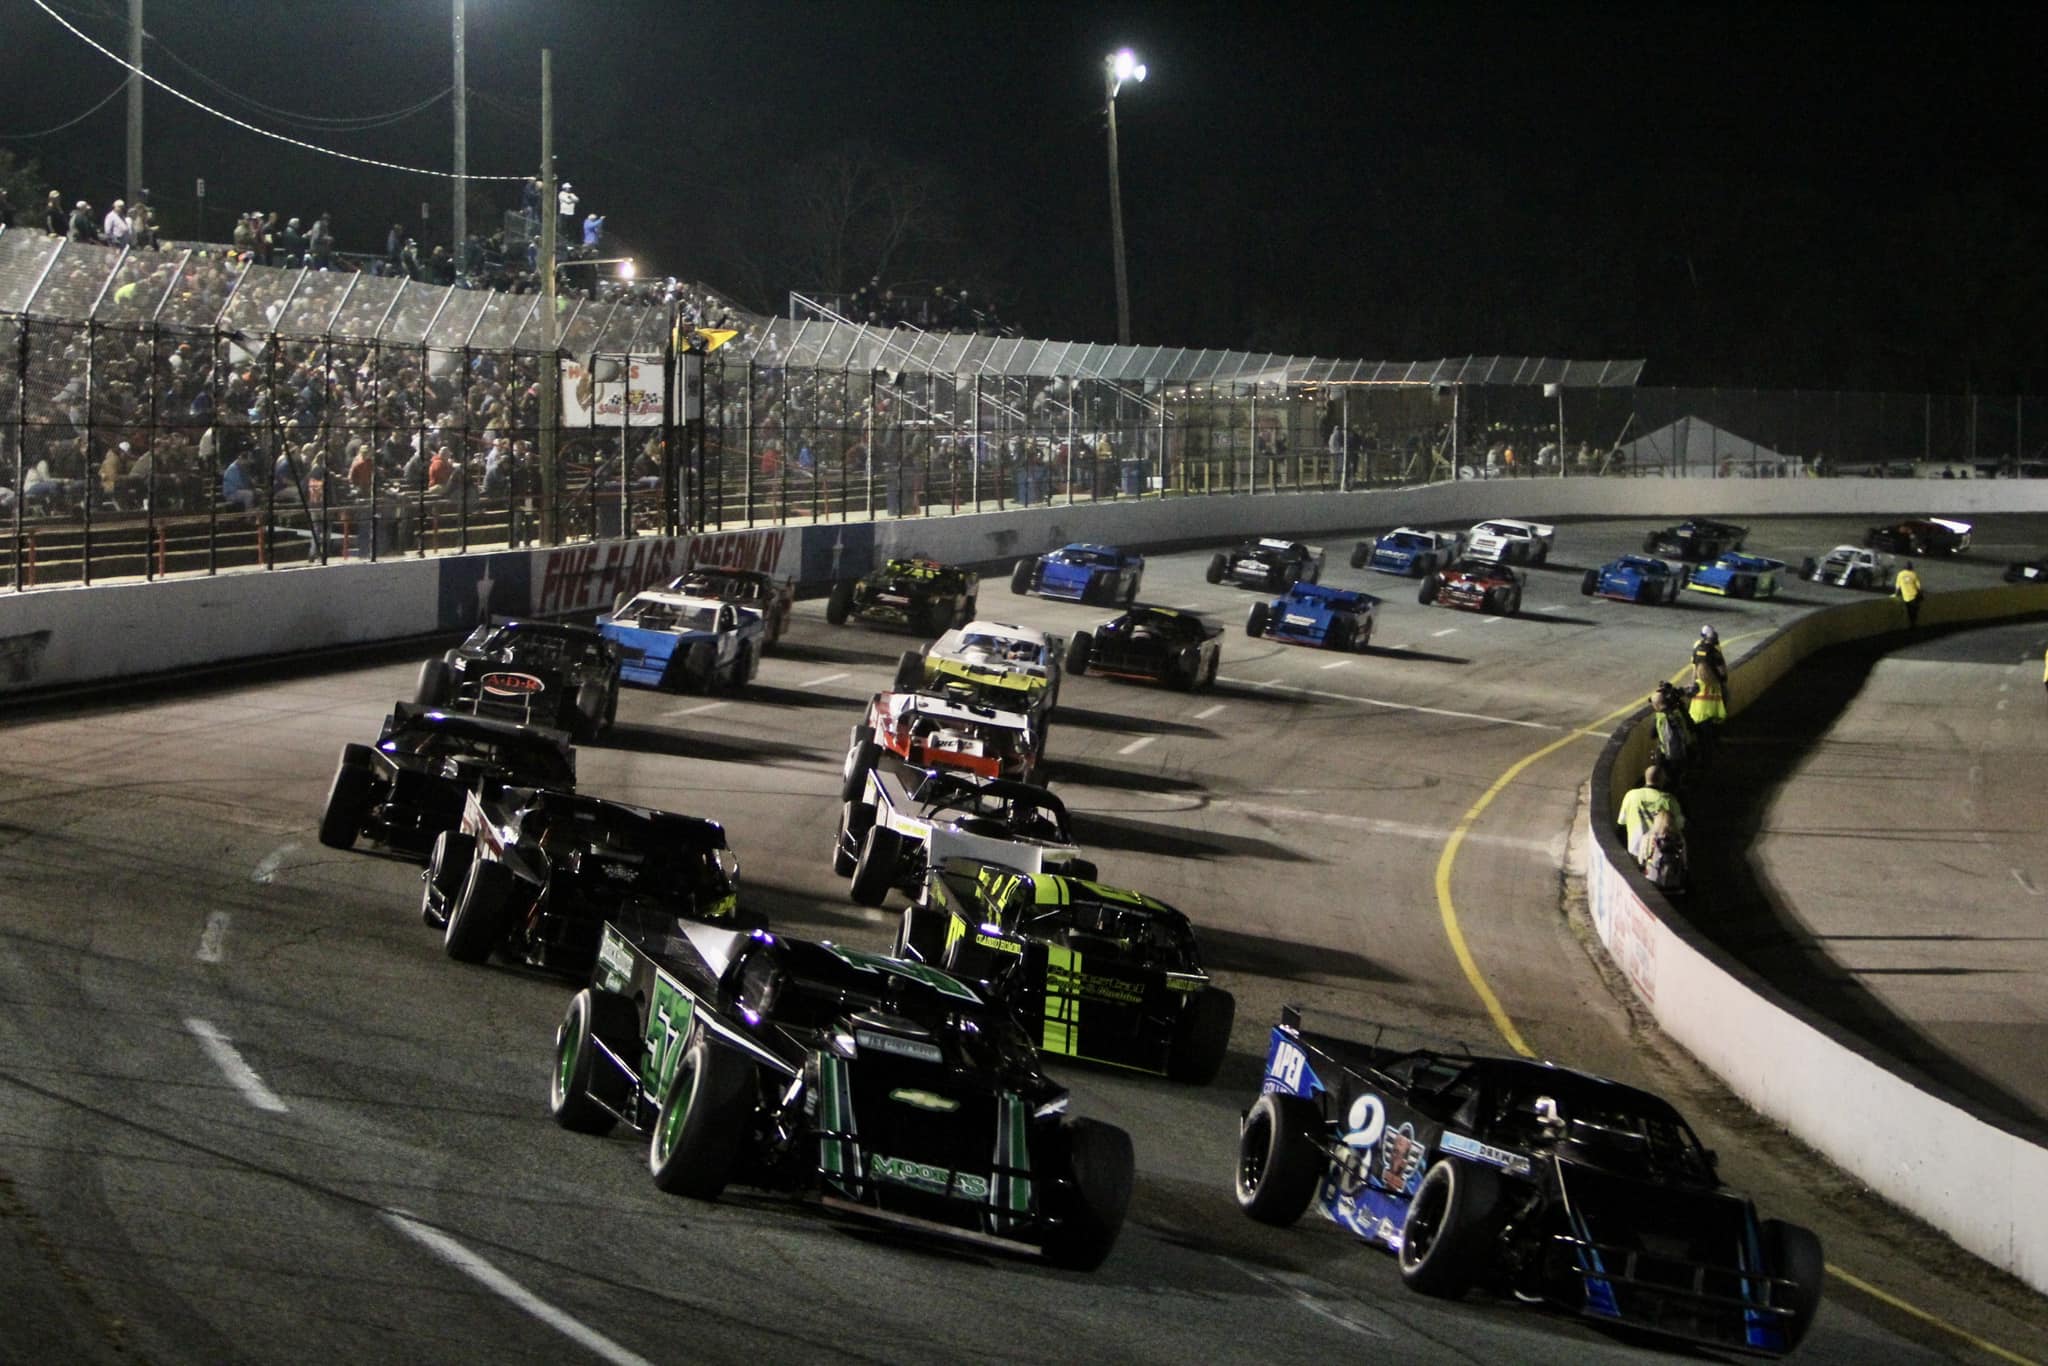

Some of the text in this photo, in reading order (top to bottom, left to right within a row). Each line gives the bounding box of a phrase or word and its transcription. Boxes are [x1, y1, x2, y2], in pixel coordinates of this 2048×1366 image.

[540, 529, 785, 612] FIVE FLAGS SPEEDWAY
